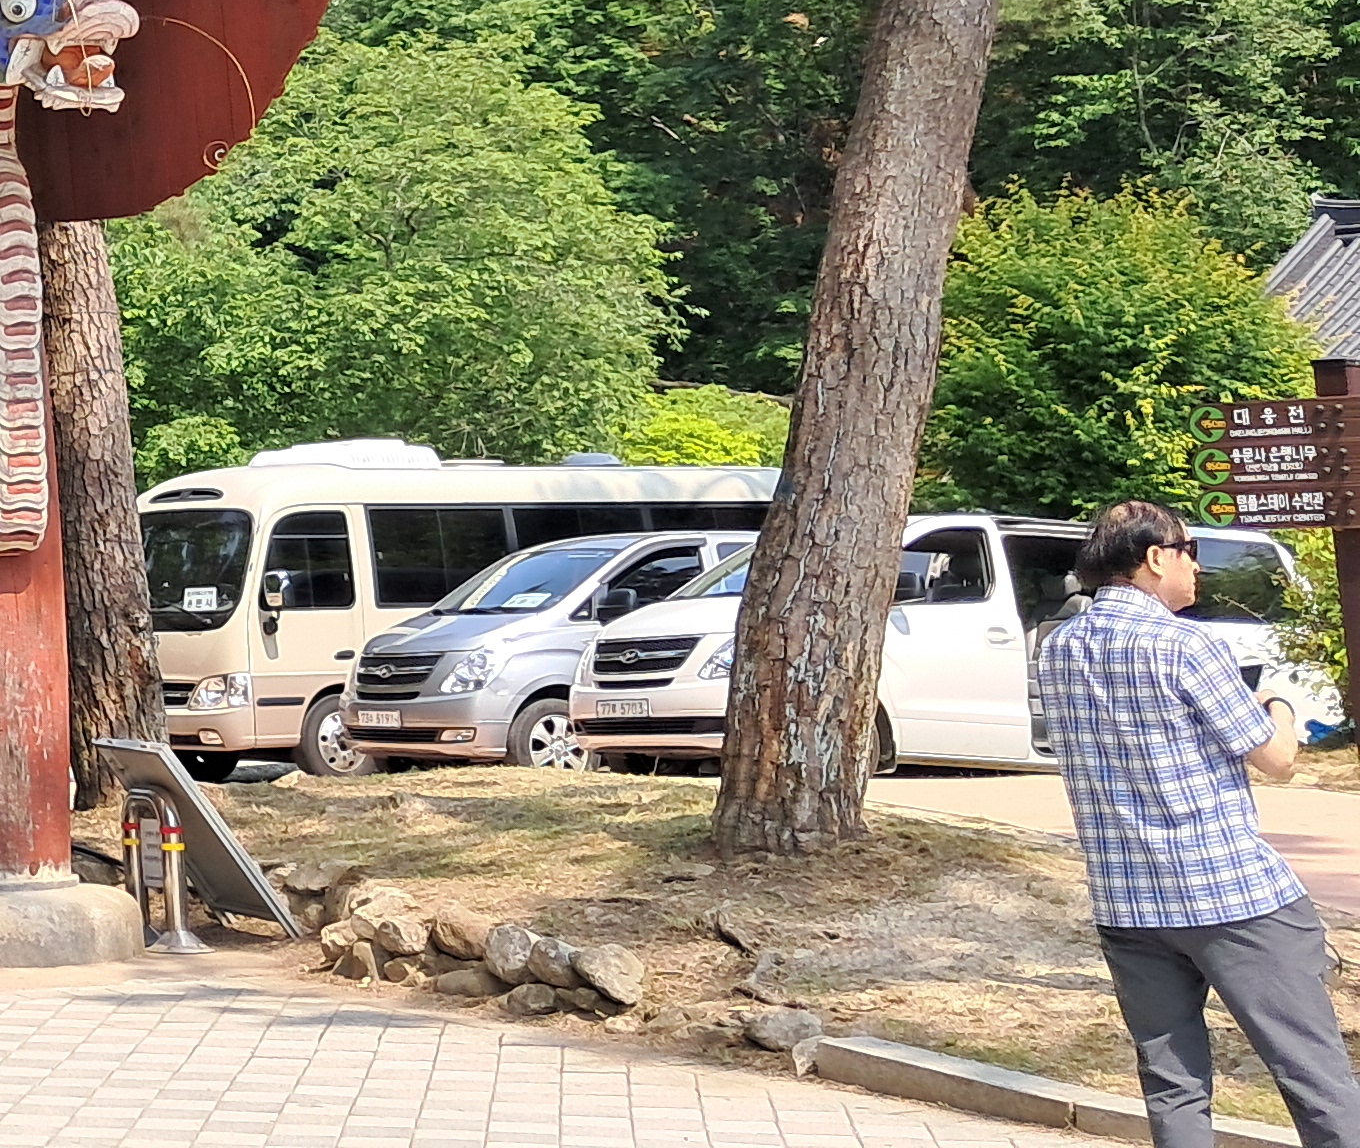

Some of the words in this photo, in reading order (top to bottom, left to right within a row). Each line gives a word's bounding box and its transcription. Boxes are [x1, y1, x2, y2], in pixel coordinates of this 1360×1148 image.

[1230, 447, 1267, 464] 용문사
[1269, 444, 1317, 462] 은행나무
[1236, 492, 1290, 512] 템플스테이
[1291, 492, 1324, 510] 수련관
